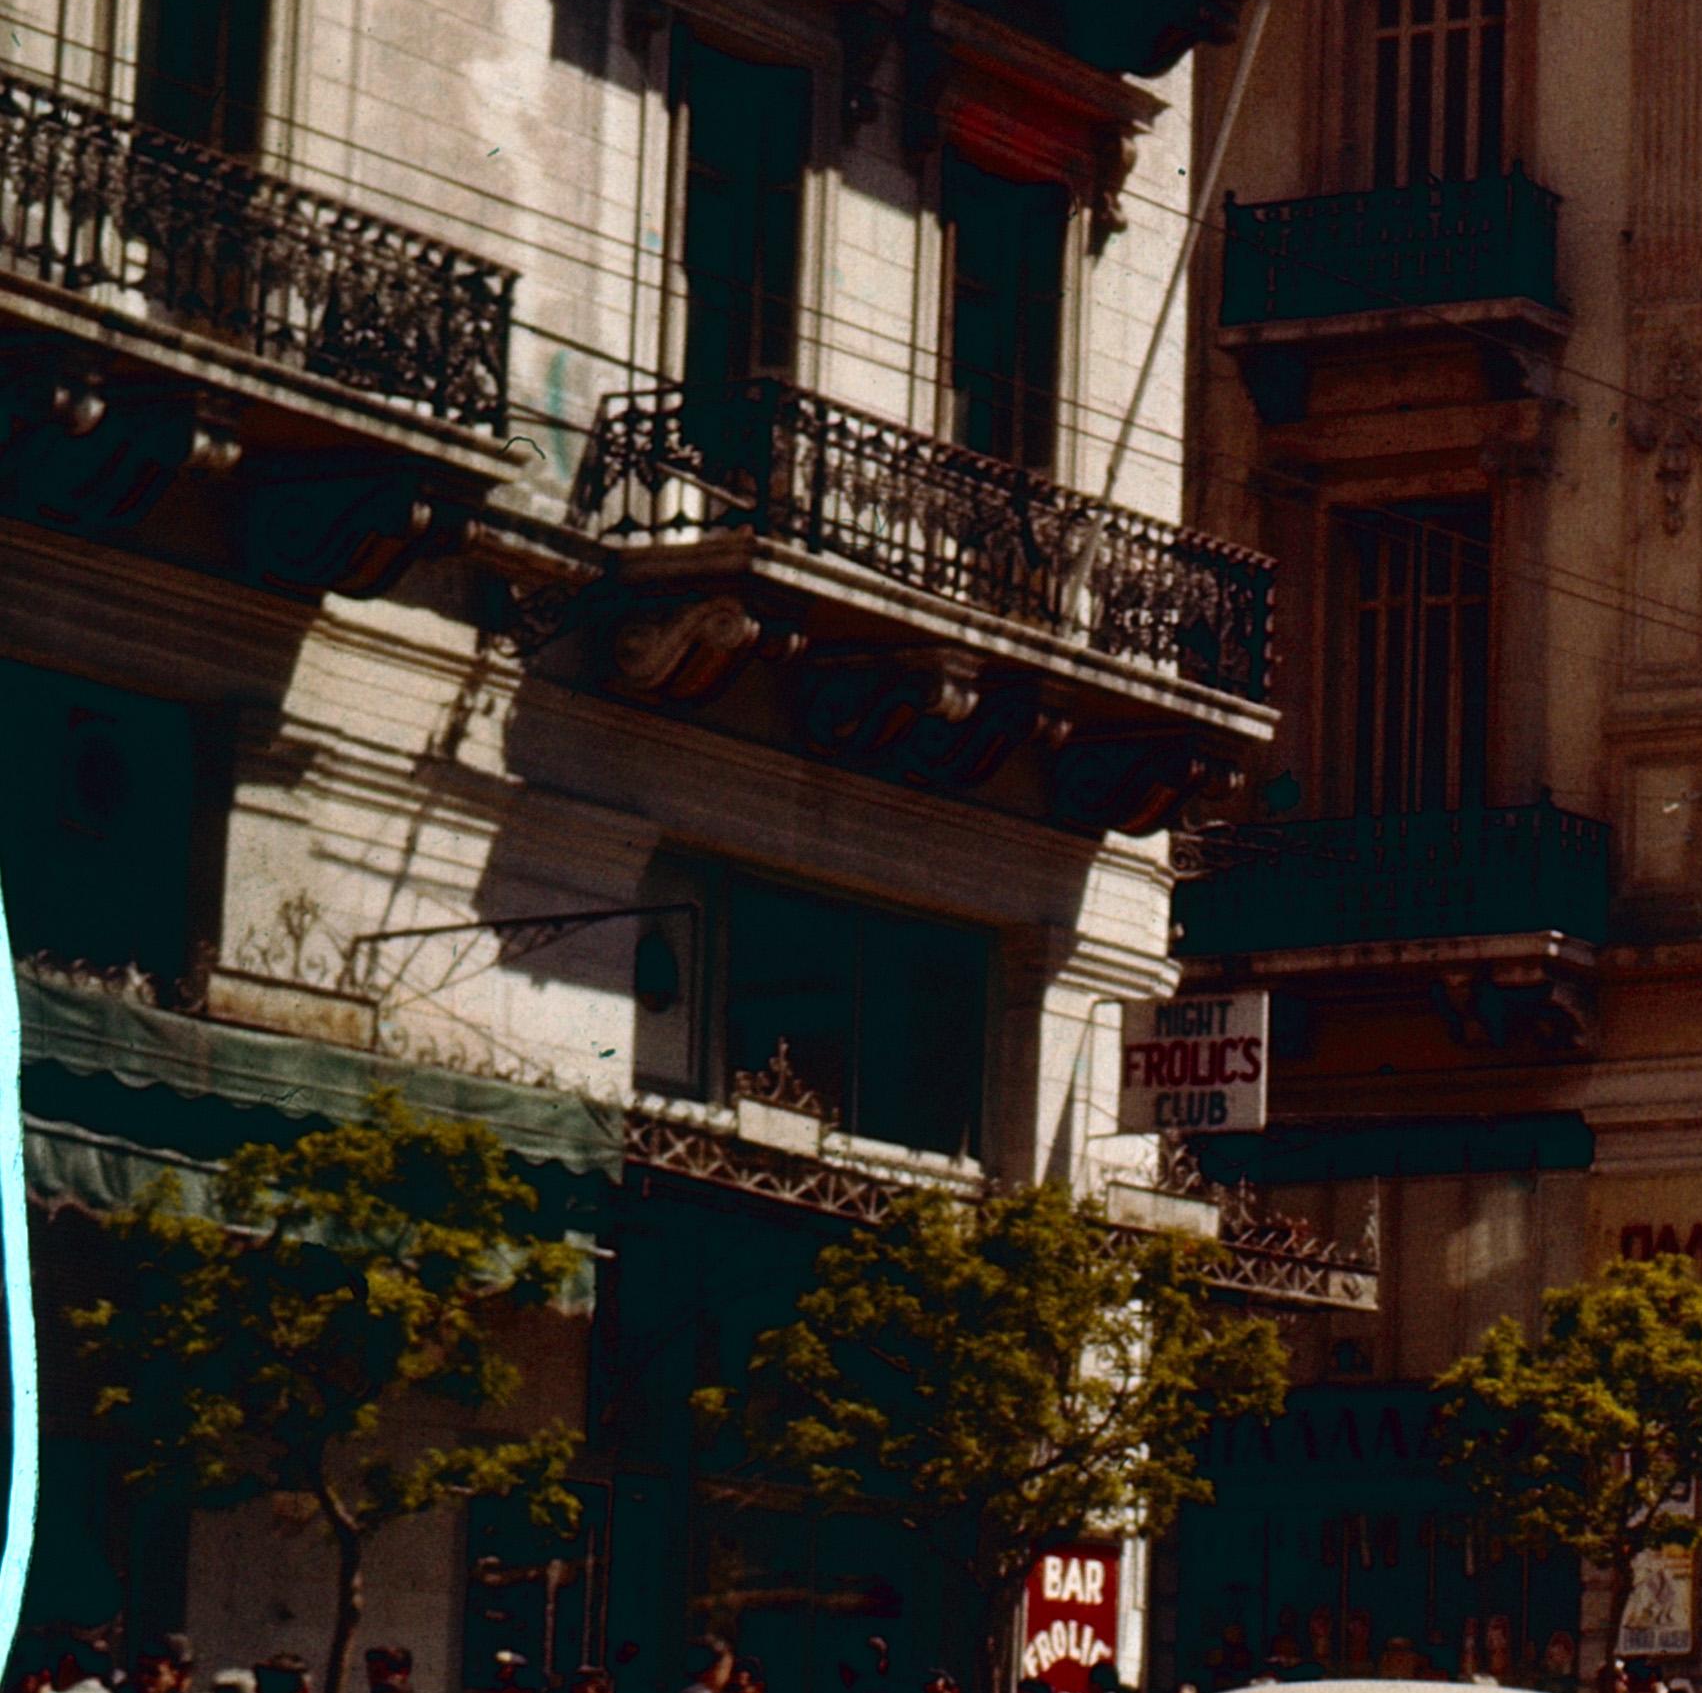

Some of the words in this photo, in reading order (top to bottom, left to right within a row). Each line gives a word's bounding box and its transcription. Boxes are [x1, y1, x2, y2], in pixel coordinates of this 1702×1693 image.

[1155, 999, 1234, 1037] NIGHT
[1125, 1035, 1263, 1088] FROLIC'S
[1155, 1089, 1229, 1128] CLUB
[1043, 1555, 1105, 1605] BAR
